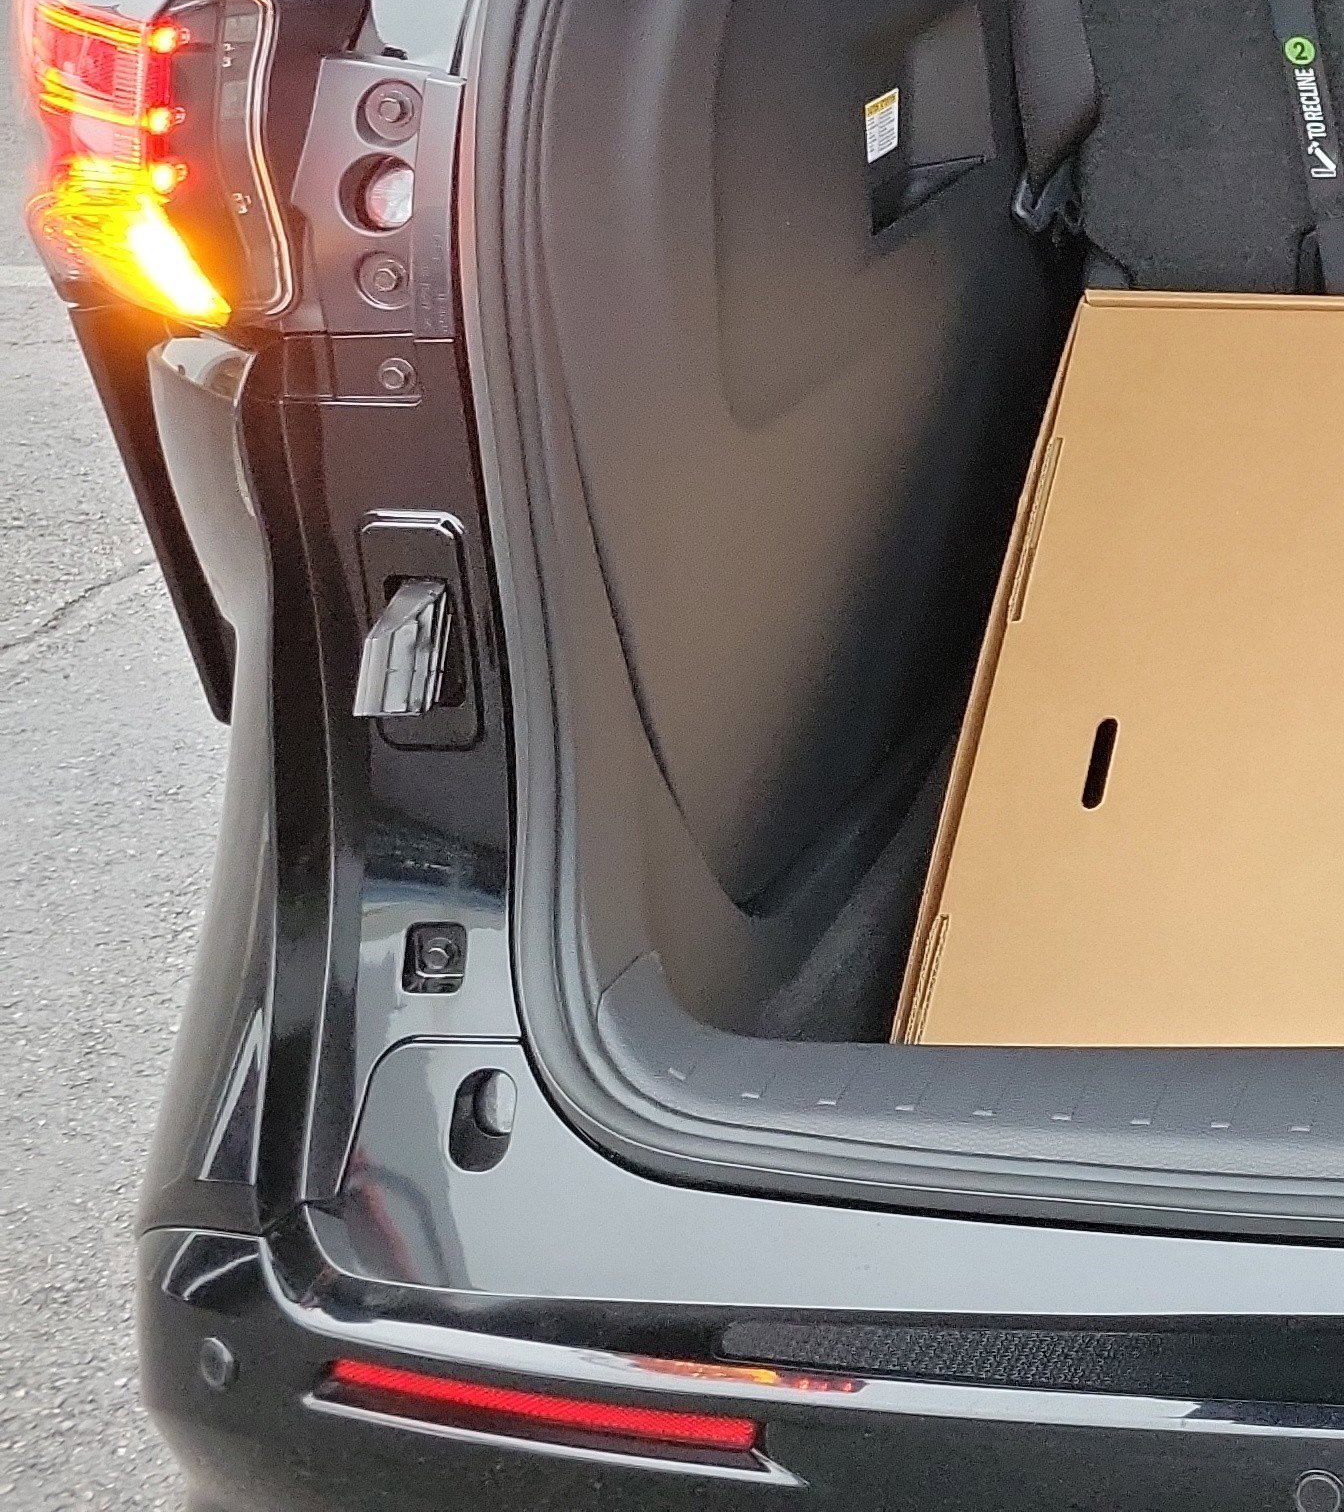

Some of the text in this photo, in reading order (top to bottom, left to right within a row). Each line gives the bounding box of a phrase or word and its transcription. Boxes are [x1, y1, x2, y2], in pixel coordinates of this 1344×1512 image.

[1293, 41, 1308, 61] 2
[1294, 67, 1327, 140] TO RECLINE
